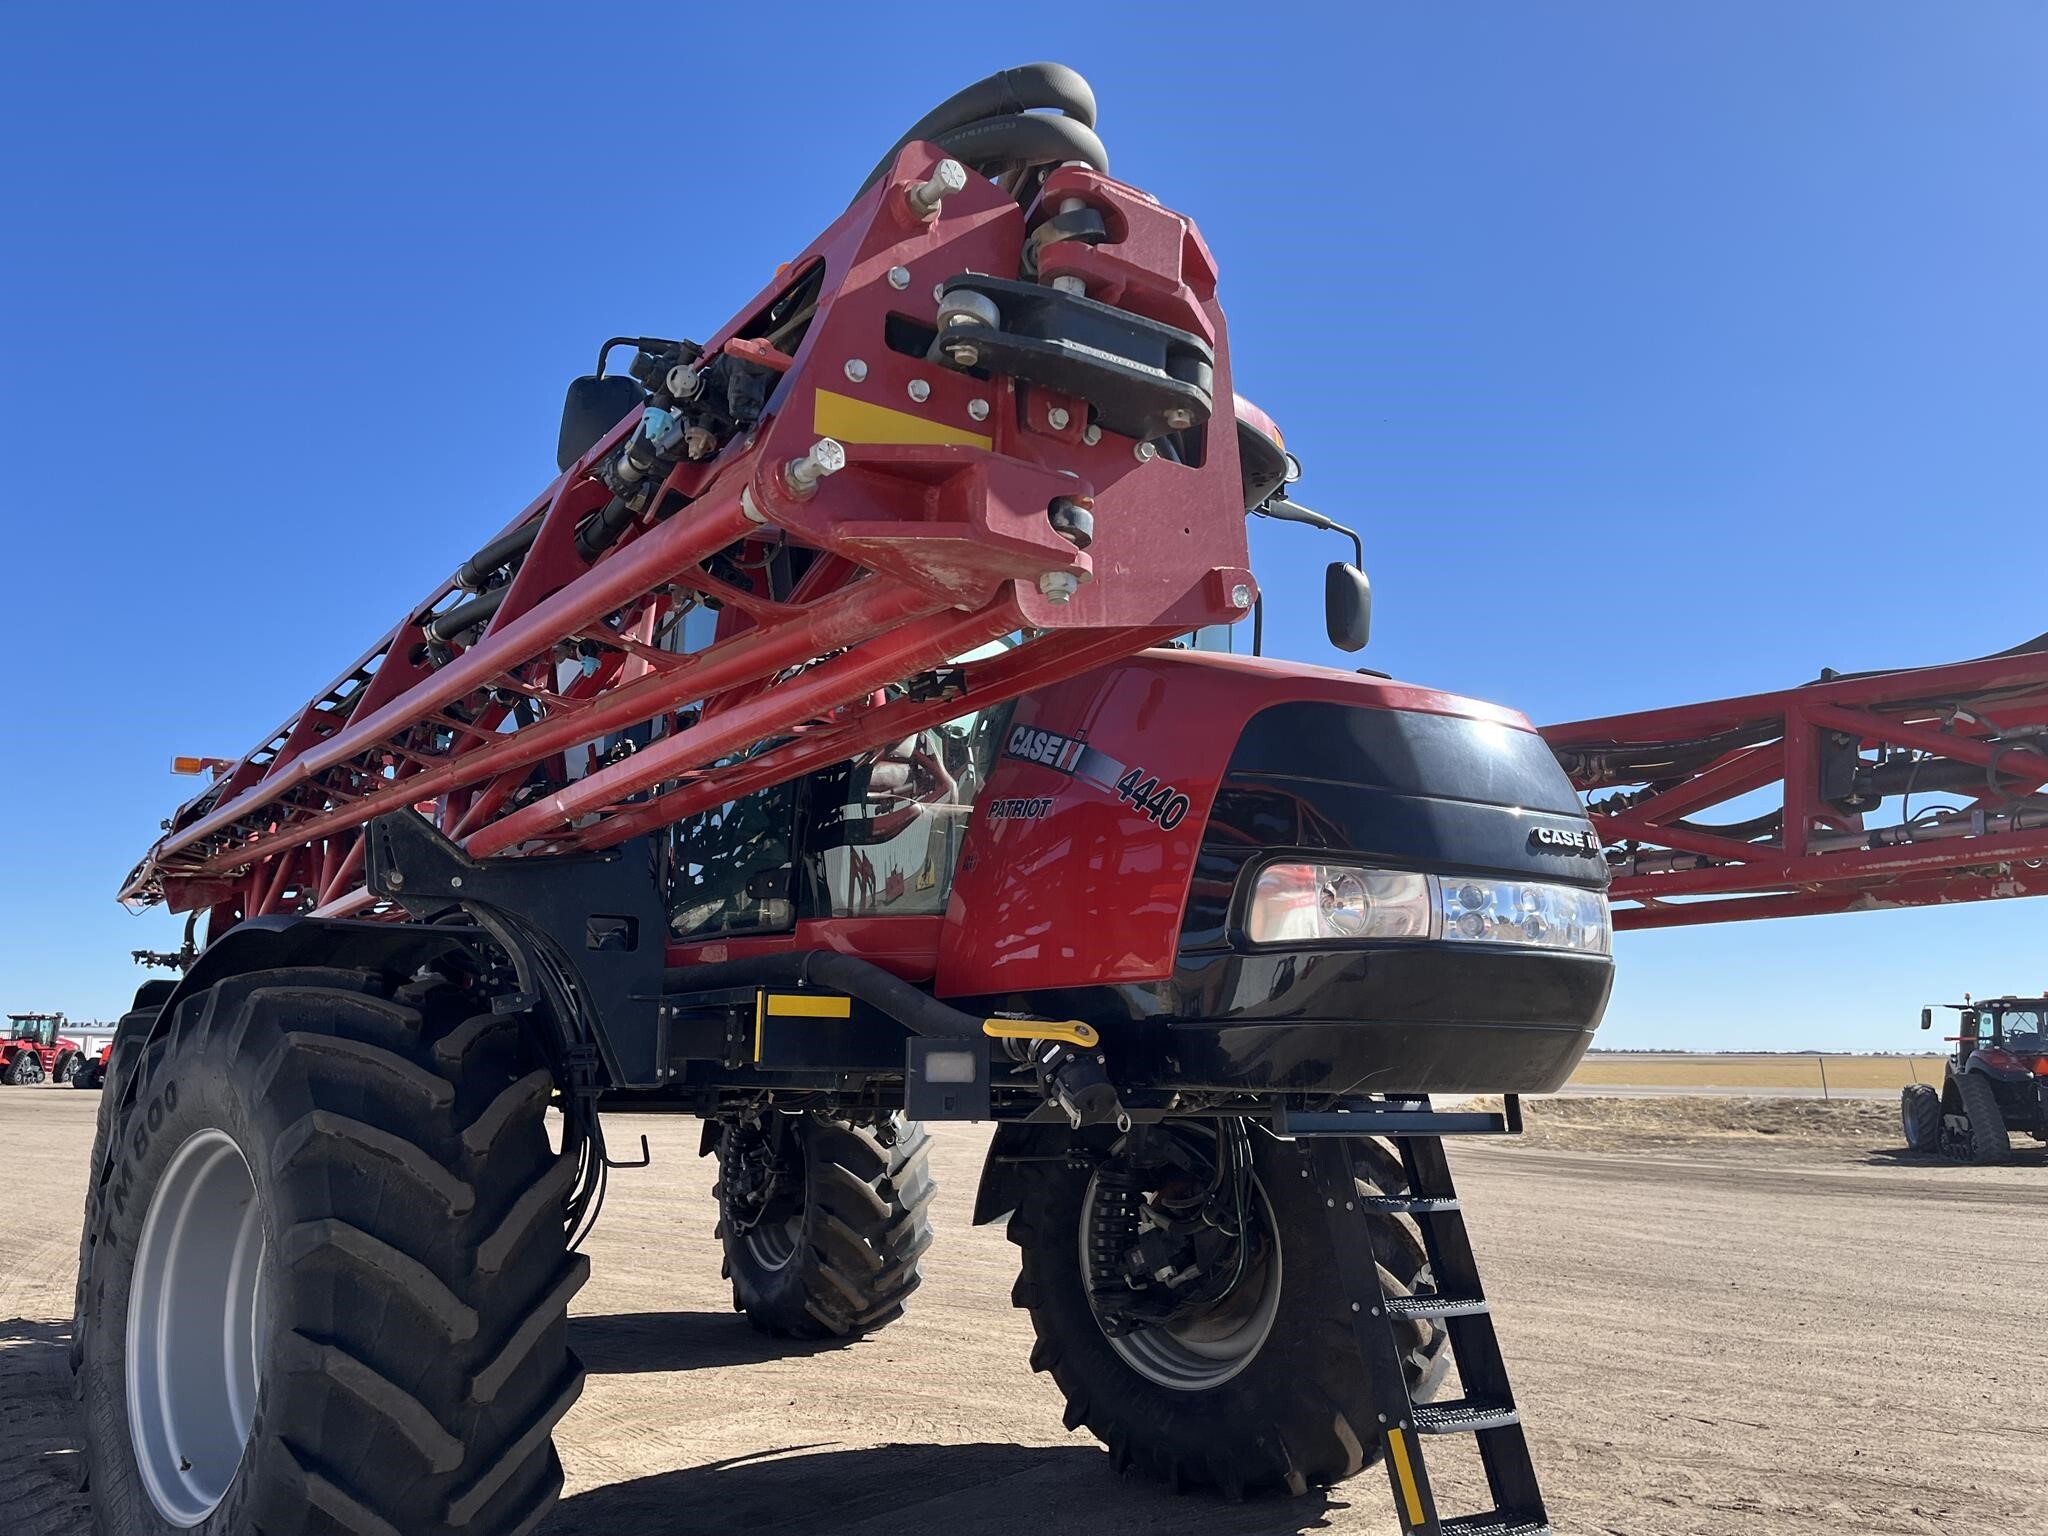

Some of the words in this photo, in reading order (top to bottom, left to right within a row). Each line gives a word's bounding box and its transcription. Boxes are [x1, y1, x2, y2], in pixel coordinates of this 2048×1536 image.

[1008, 726, 1063, 766] CASE
[986, 798, 1053, 819] PATRIOT
[1115, 767, 1190, 831] 4440
[1537, 827, 1585, 848] CASE
